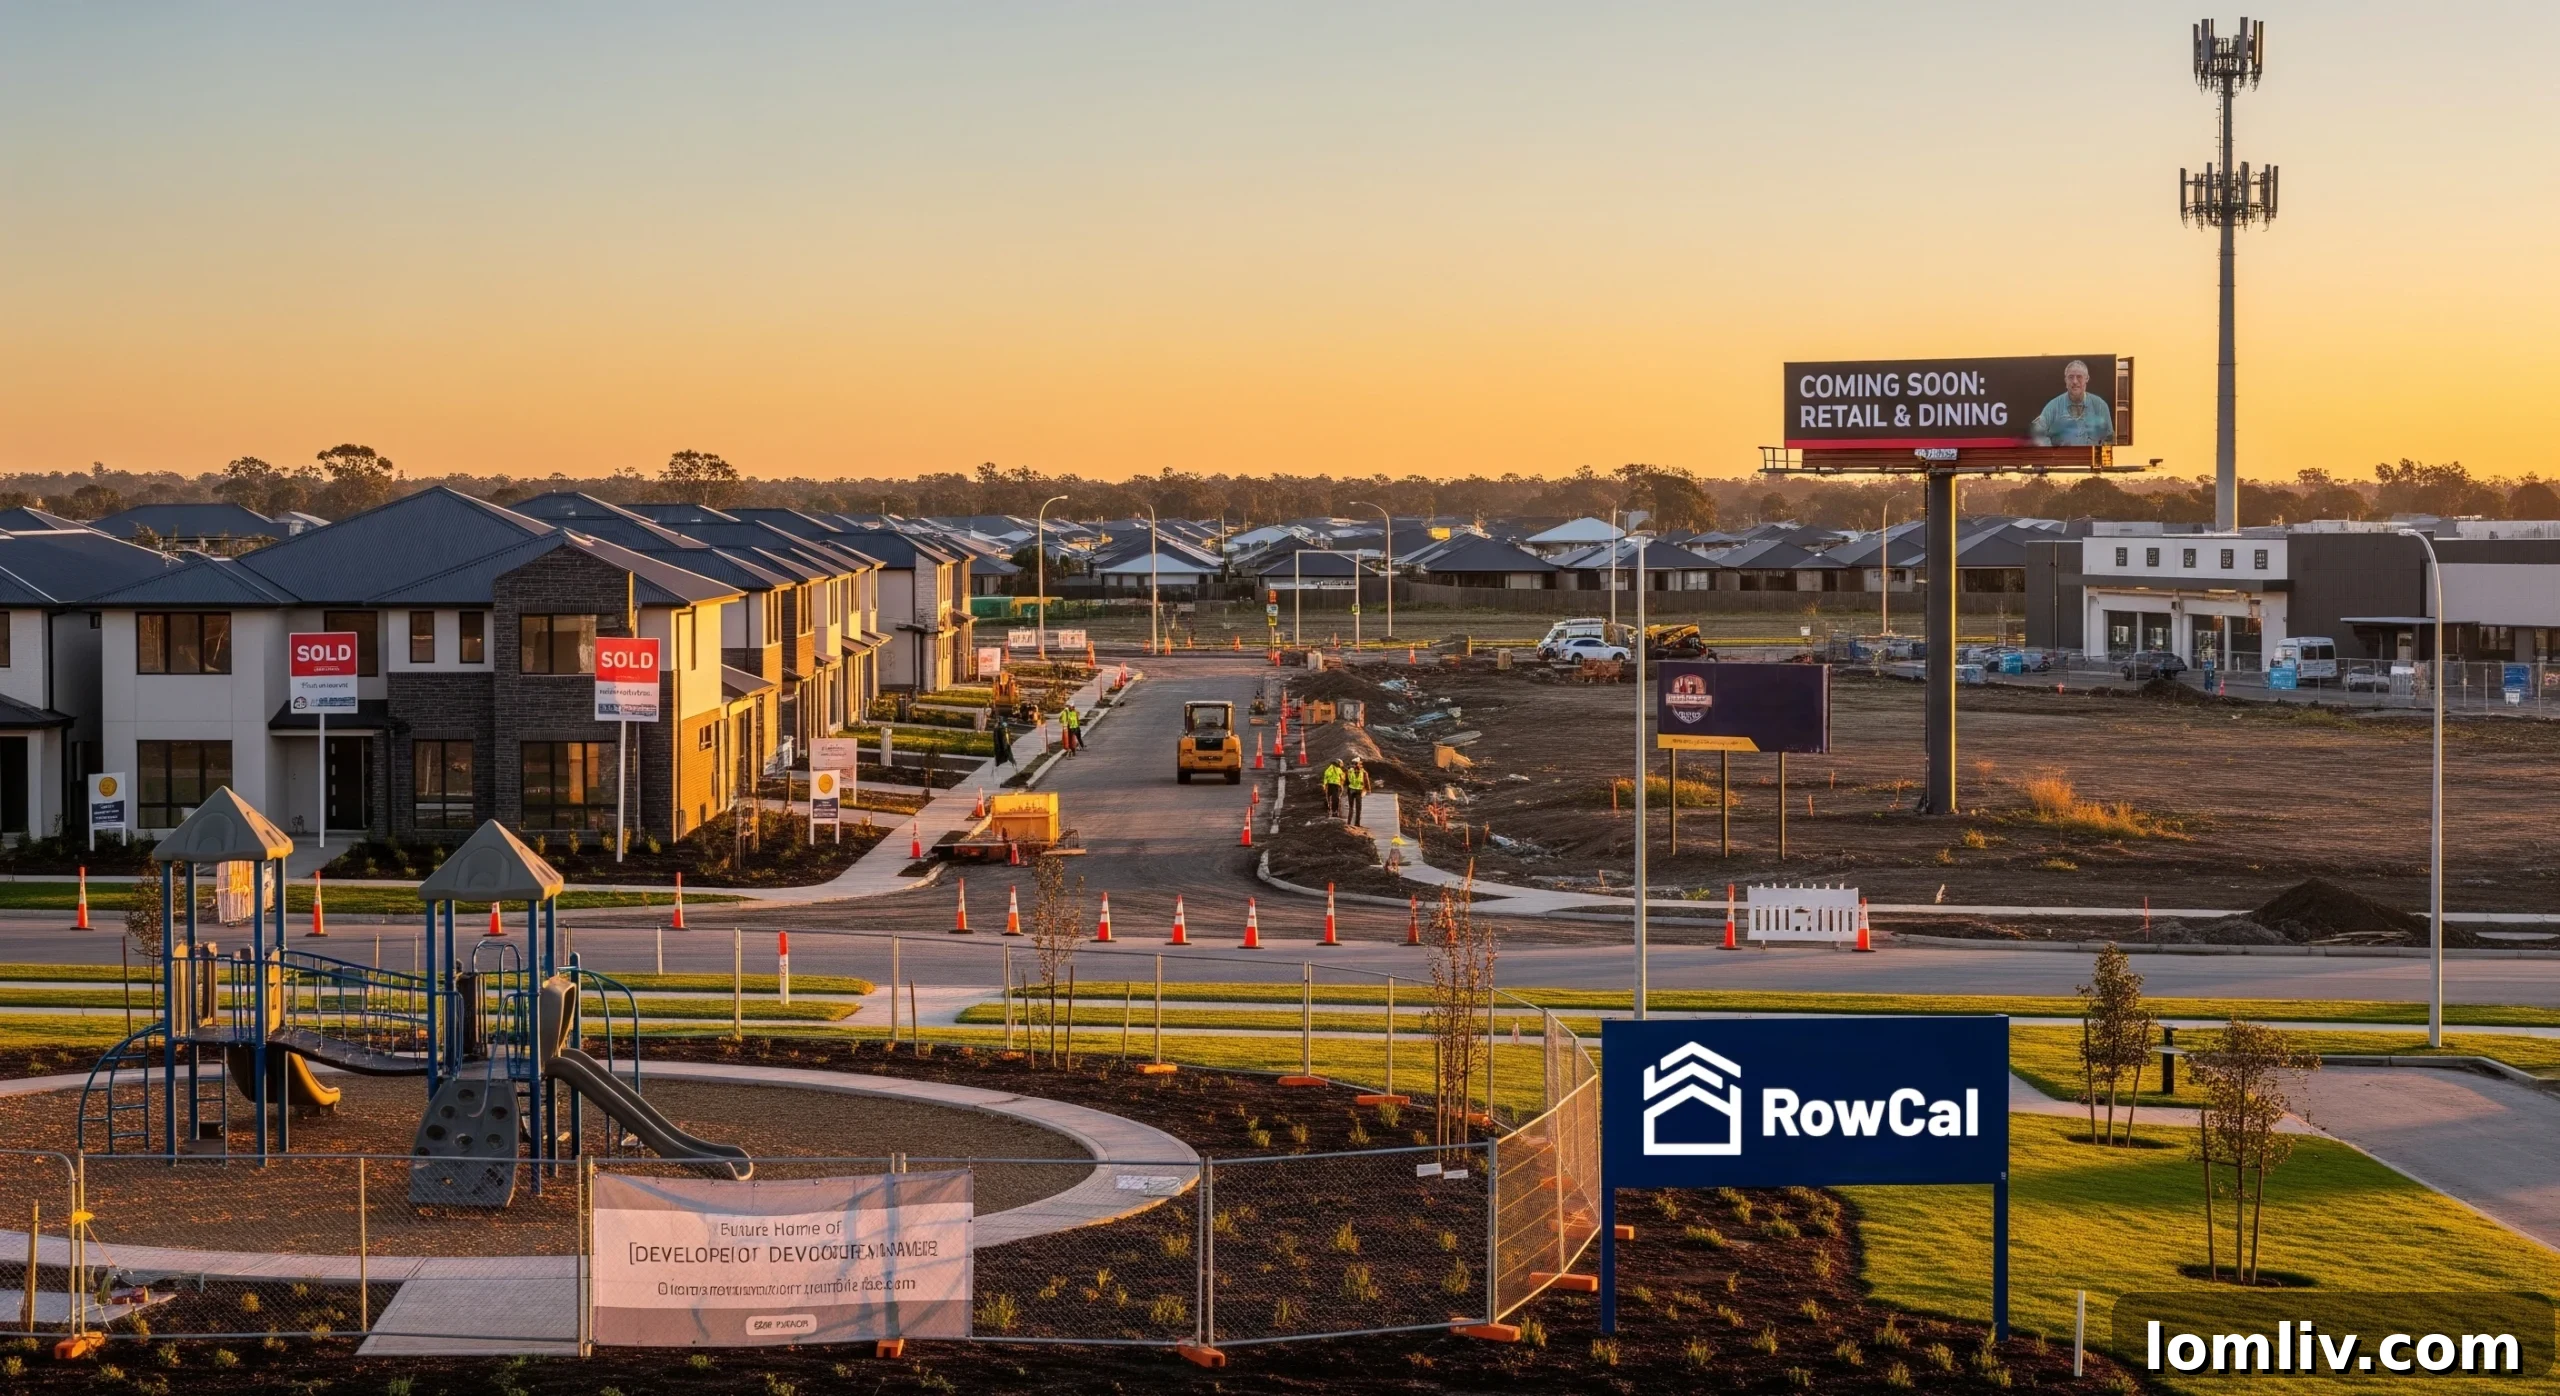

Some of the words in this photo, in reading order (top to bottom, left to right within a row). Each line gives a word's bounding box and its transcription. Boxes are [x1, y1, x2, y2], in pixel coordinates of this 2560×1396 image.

[1799, 373, 1900, 399] COMING
[1906, 370, 1987, 397] SOON:
[1799, 404, 1888, 429] RETAIL
[1893, 404, 1912, 428] &
[1919, 402, 2009, 428] DINING
[297, 644, 352, 662] SOLD
[601, 651, 654, 669] SOLD
[1762, 1087, 1979, 1137] RowCal
[825, 1220, 843, 1235] of
